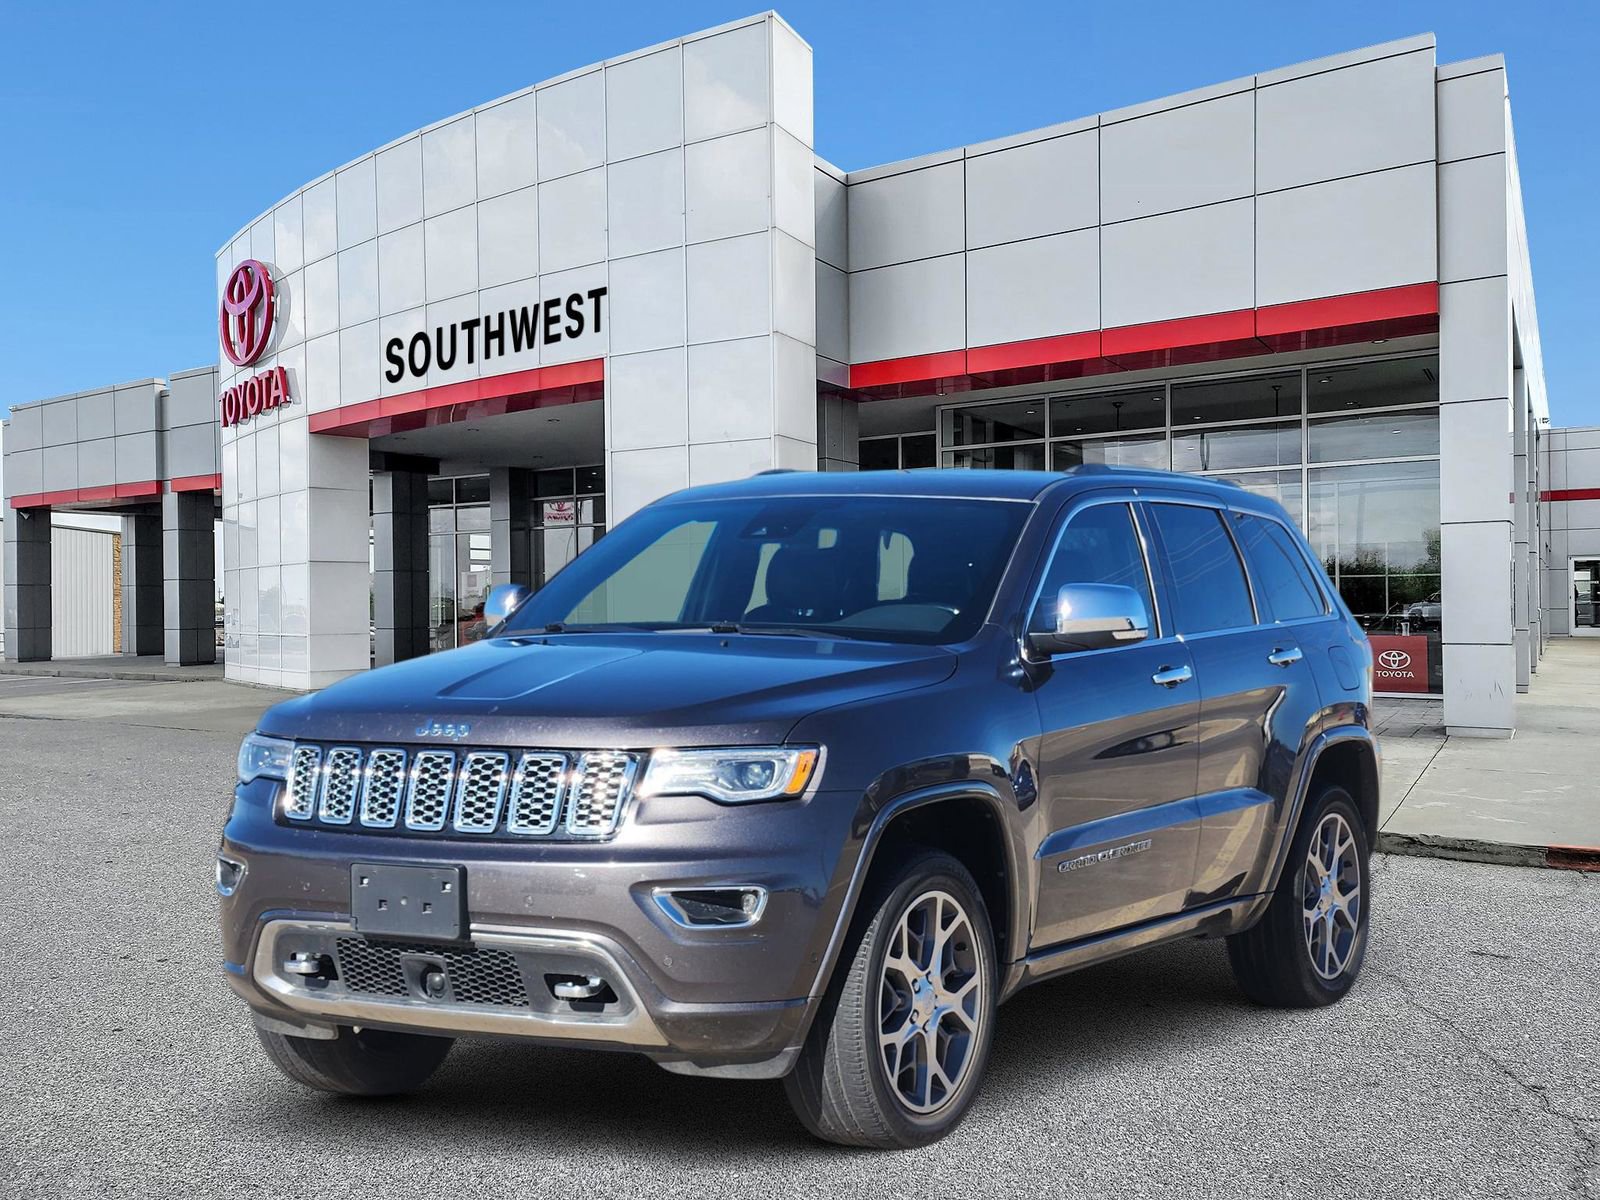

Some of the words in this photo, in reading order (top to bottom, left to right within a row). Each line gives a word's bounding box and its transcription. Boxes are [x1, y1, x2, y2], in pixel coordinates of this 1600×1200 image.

[385, 286, 608, 383] SOUTHWEST
[218, 366, 290, 428] TOYOTA
[1375, 670, 1415, 678] TOYOTA
[415, 719, 471, 741] Jeep
[1058, 854, 1098, 873] GRAND
